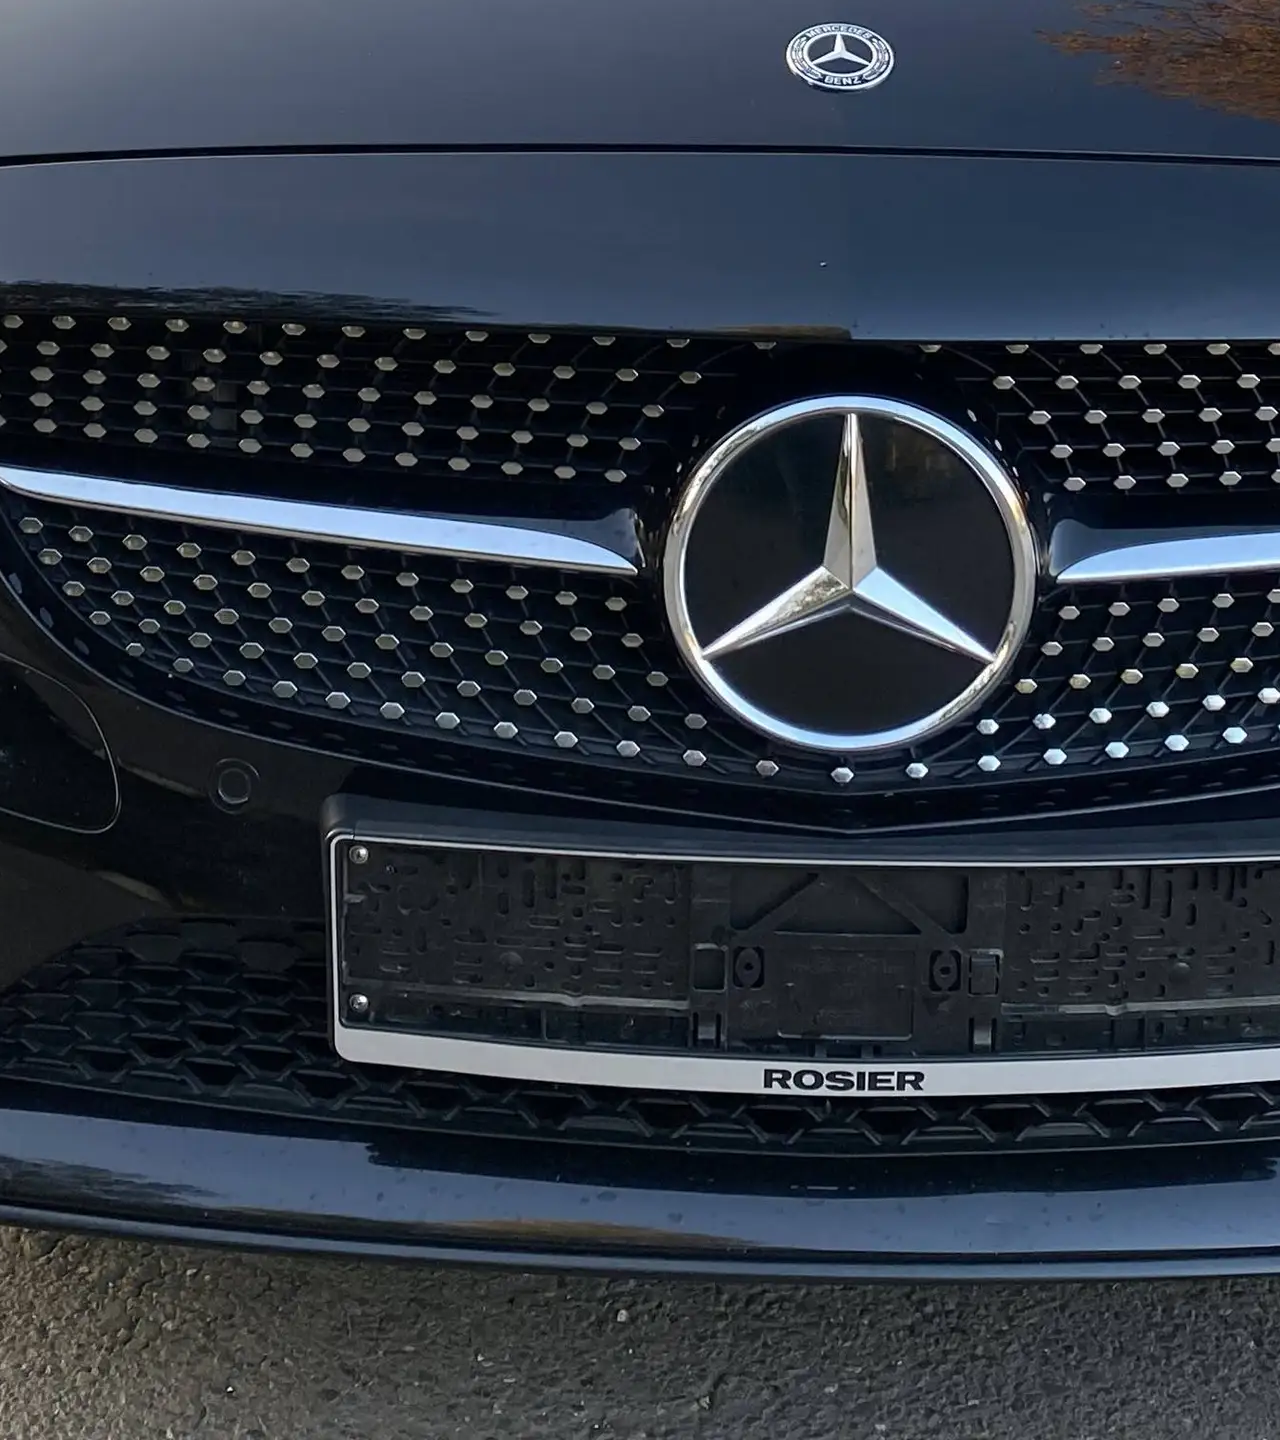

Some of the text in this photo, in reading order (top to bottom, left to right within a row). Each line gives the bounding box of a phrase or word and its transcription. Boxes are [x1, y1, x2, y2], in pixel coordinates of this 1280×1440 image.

[805, 24, 873, 40] MERCEDES
[823, 75, 862, 86] BENZ
[763, 1068, 925, 1092] ROSIER
